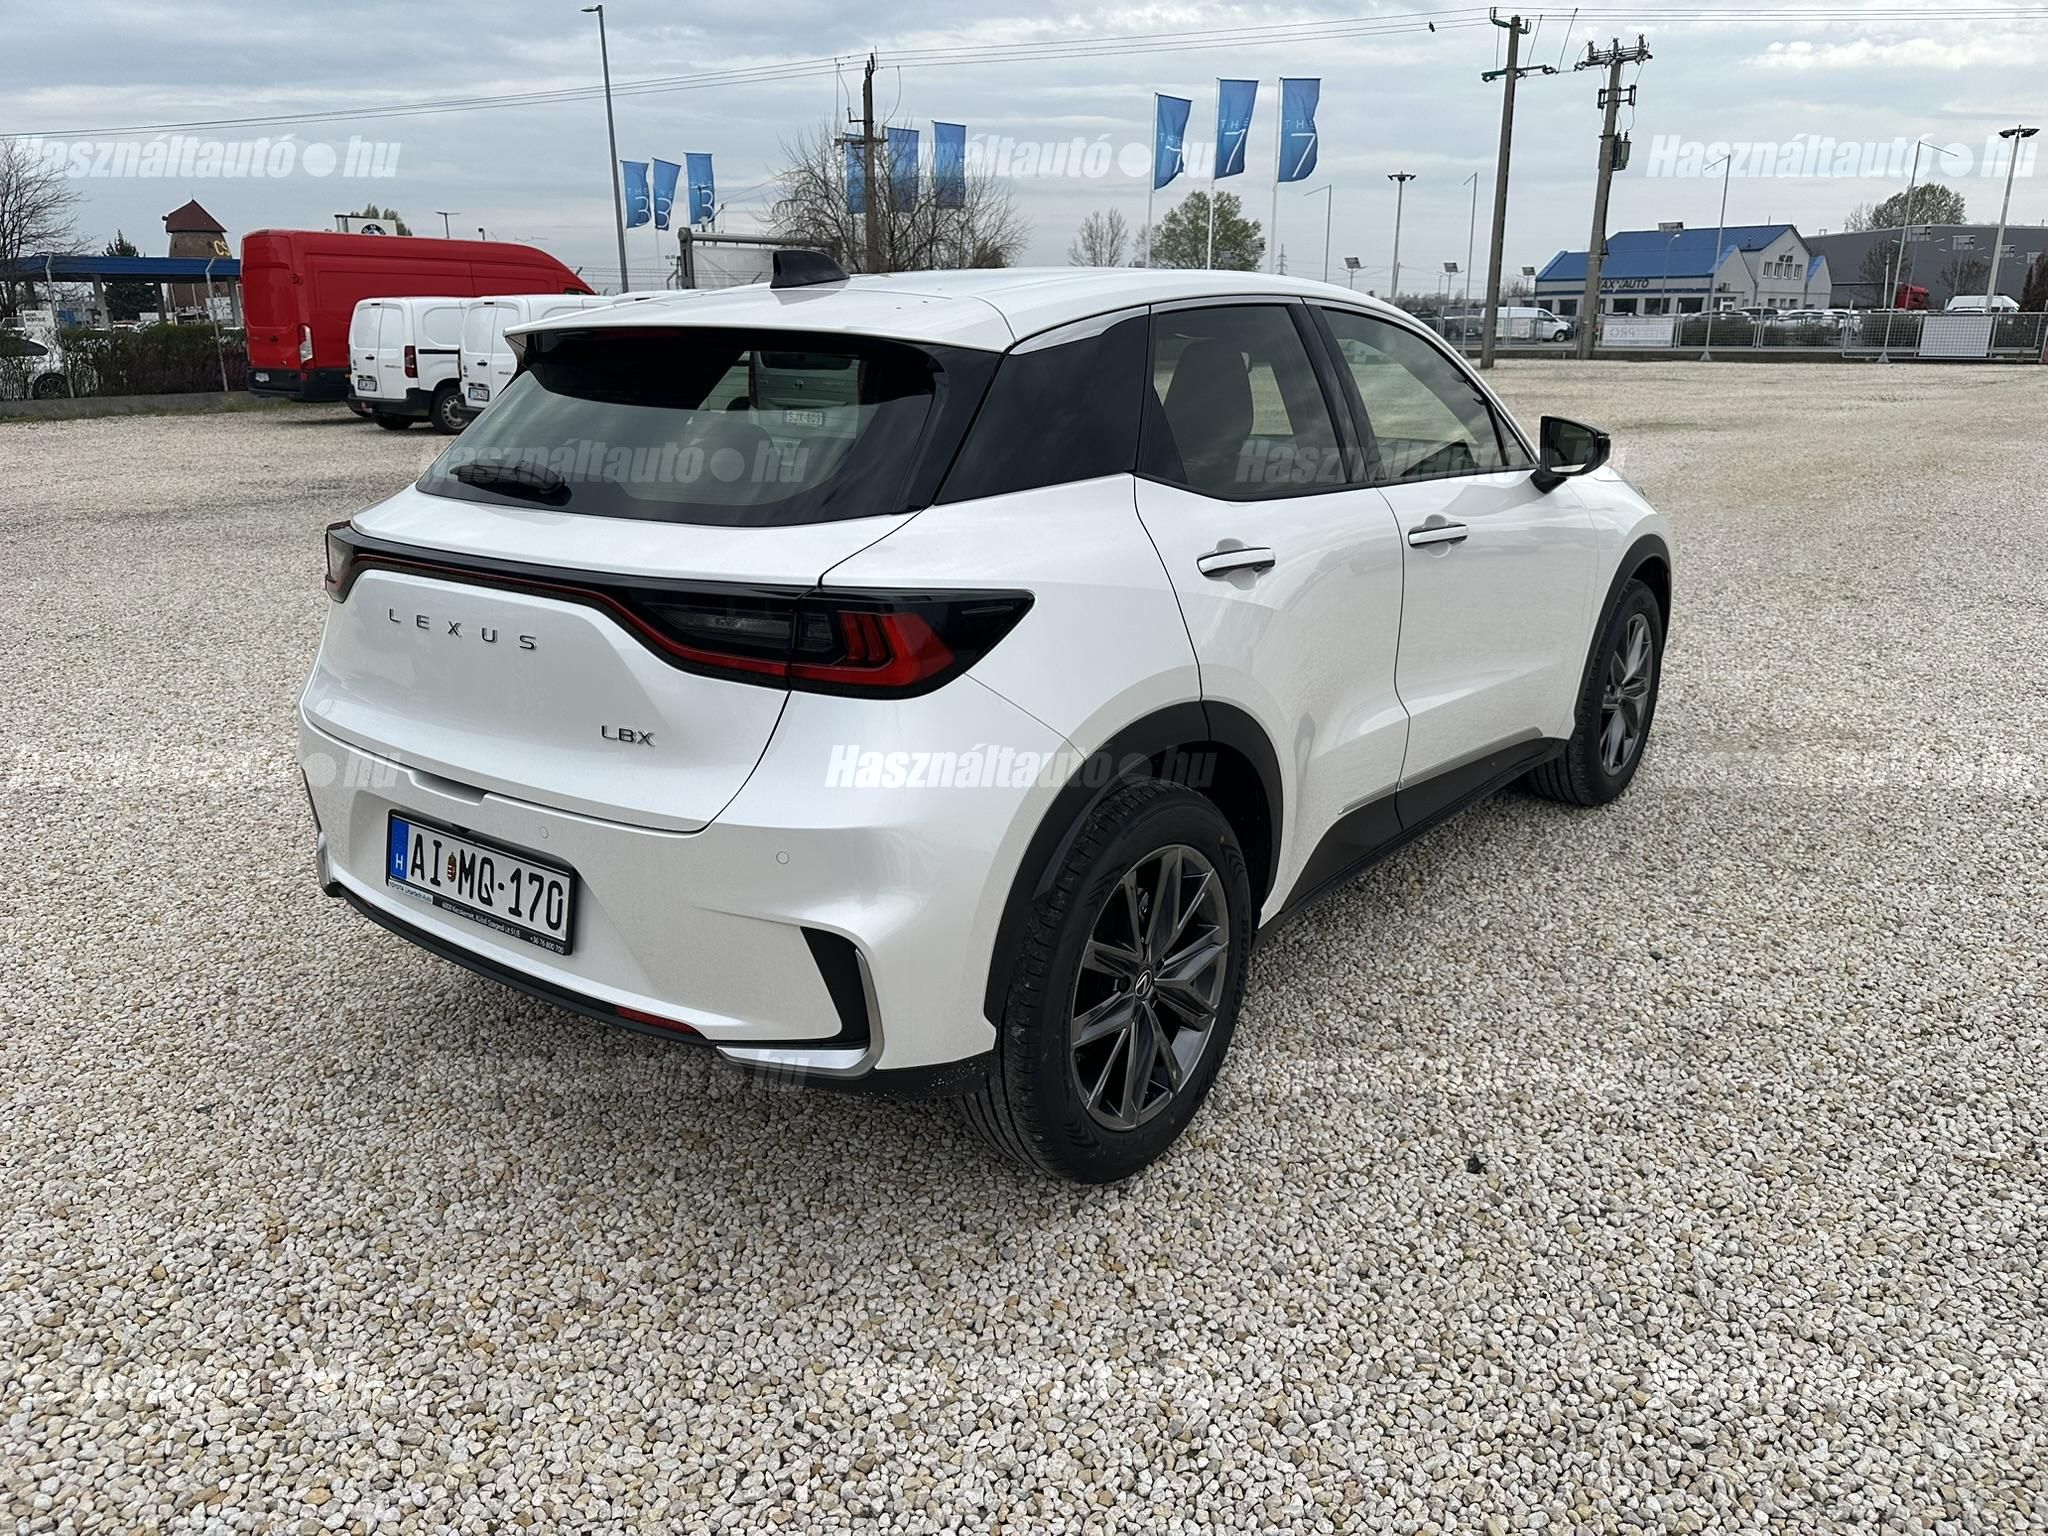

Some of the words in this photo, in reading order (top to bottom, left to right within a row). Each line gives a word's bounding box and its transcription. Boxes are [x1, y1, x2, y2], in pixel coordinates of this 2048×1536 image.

[1285, 119, 1316, 129] THE
[1224, 129, 1247, 173] 7
[1290, 132, 1316, 178] 7
[635, 196, 651, 226] 3
[656, 197, 672, 229] 3
[389, 608, 537, 650] LEXUS
[601, 725, 656, 747] LBX
[394, 854, 404, 870] H
